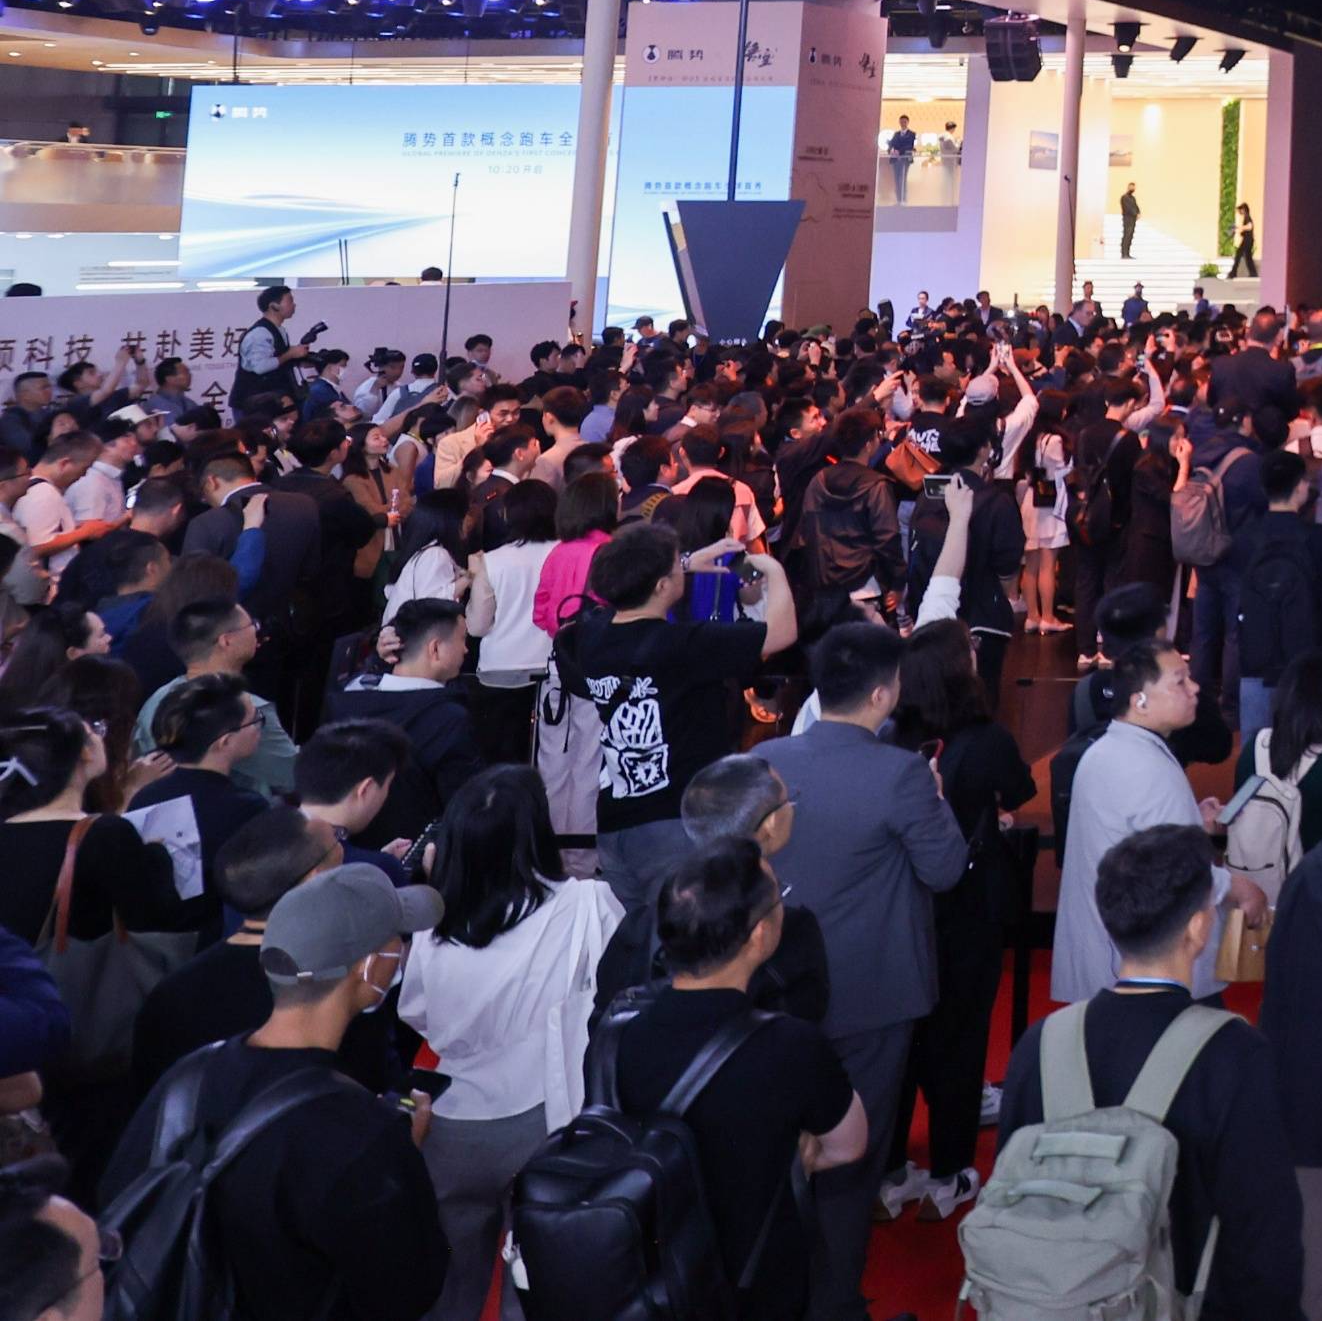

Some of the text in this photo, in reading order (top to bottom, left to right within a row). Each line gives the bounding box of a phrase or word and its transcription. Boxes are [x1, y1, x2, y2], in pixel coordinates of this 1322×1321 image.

[403, 132, 612, 147] 腾势首款概念跑车全
